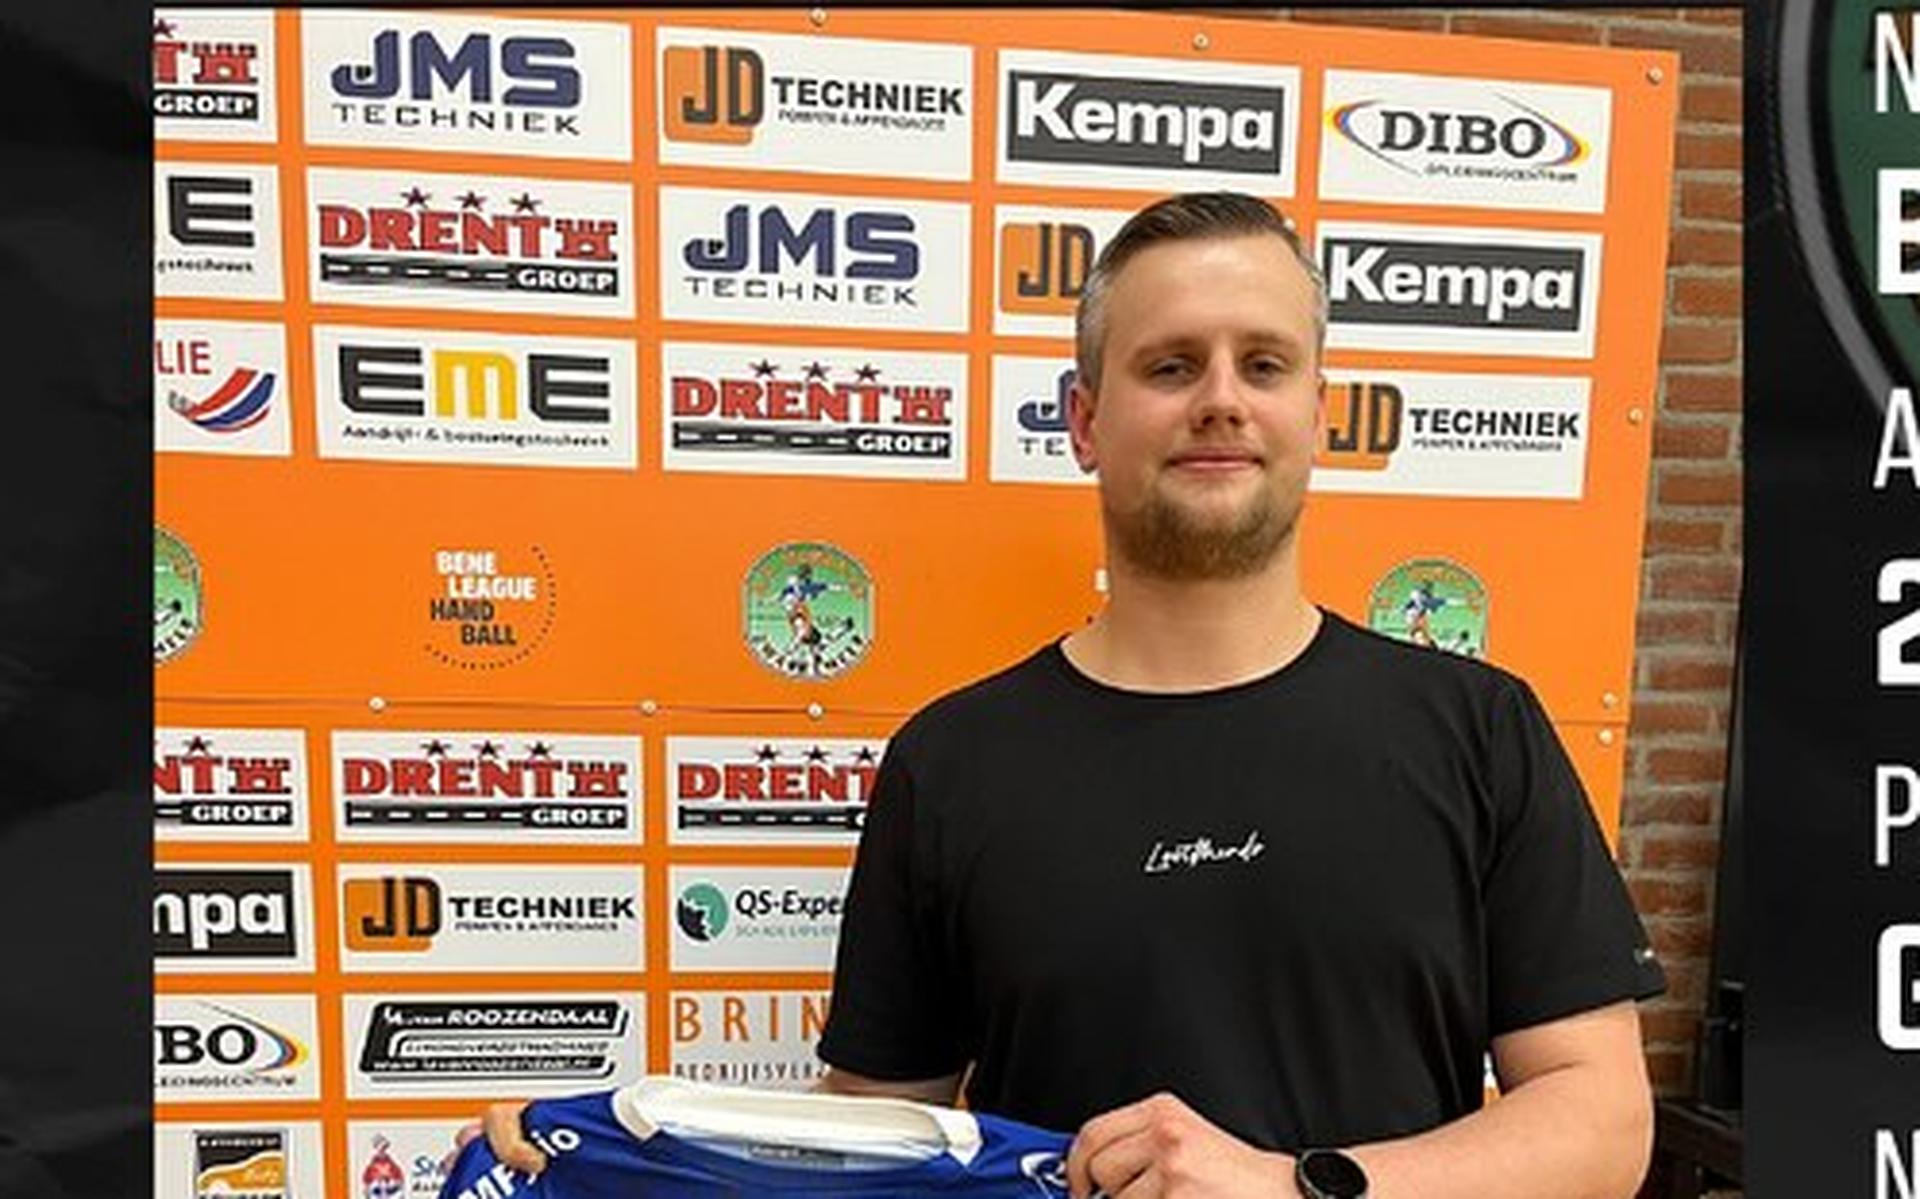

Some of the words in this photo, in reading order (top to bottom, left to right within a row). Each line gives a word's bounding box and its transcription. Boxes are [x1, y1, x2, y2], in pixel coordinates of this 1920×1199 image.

[330, 30, 582, 109] JMS
[682, 46, 764, 127] JD
[771, 77, 965, 115] TECHNIEK
[154, 94, 253, 113] GROEP
[333, 103, 581, 135] TECHNIEK
[1017, 80, 1273, 163] Kempa
[1379, 110, 1546, 159] DIBO
[683, 205, 919, 281] JMS
[1018, 223, 1094, 297] JD
[518, 269, 615, 290] GROEP
[684, 277, 918, 306] TECHNIEK
[1330, 245, 1574, 321] Kempa
[1328, 382, 1403, 454] JD
[1409, 409, 1579, 438] TECHNIEK
[856, 433, 948, 453] GROEP
[437, 551, 497, 575] BENE
[449, 577, 537, 600] LEAGUE
[431, 600, 494, 620] HAND
[461, 625, 517, 646] BALL
[192, 805, 288, 821] GROEP
[532, 807, 623, 825] GROEP
[362, 877, 441, 938] JD
[449, 897, 636, 920] TECHNIEK
[447, 1008, 611, 1026] ROOZENDAAL
[155, 1024, 256, 1066] BO
